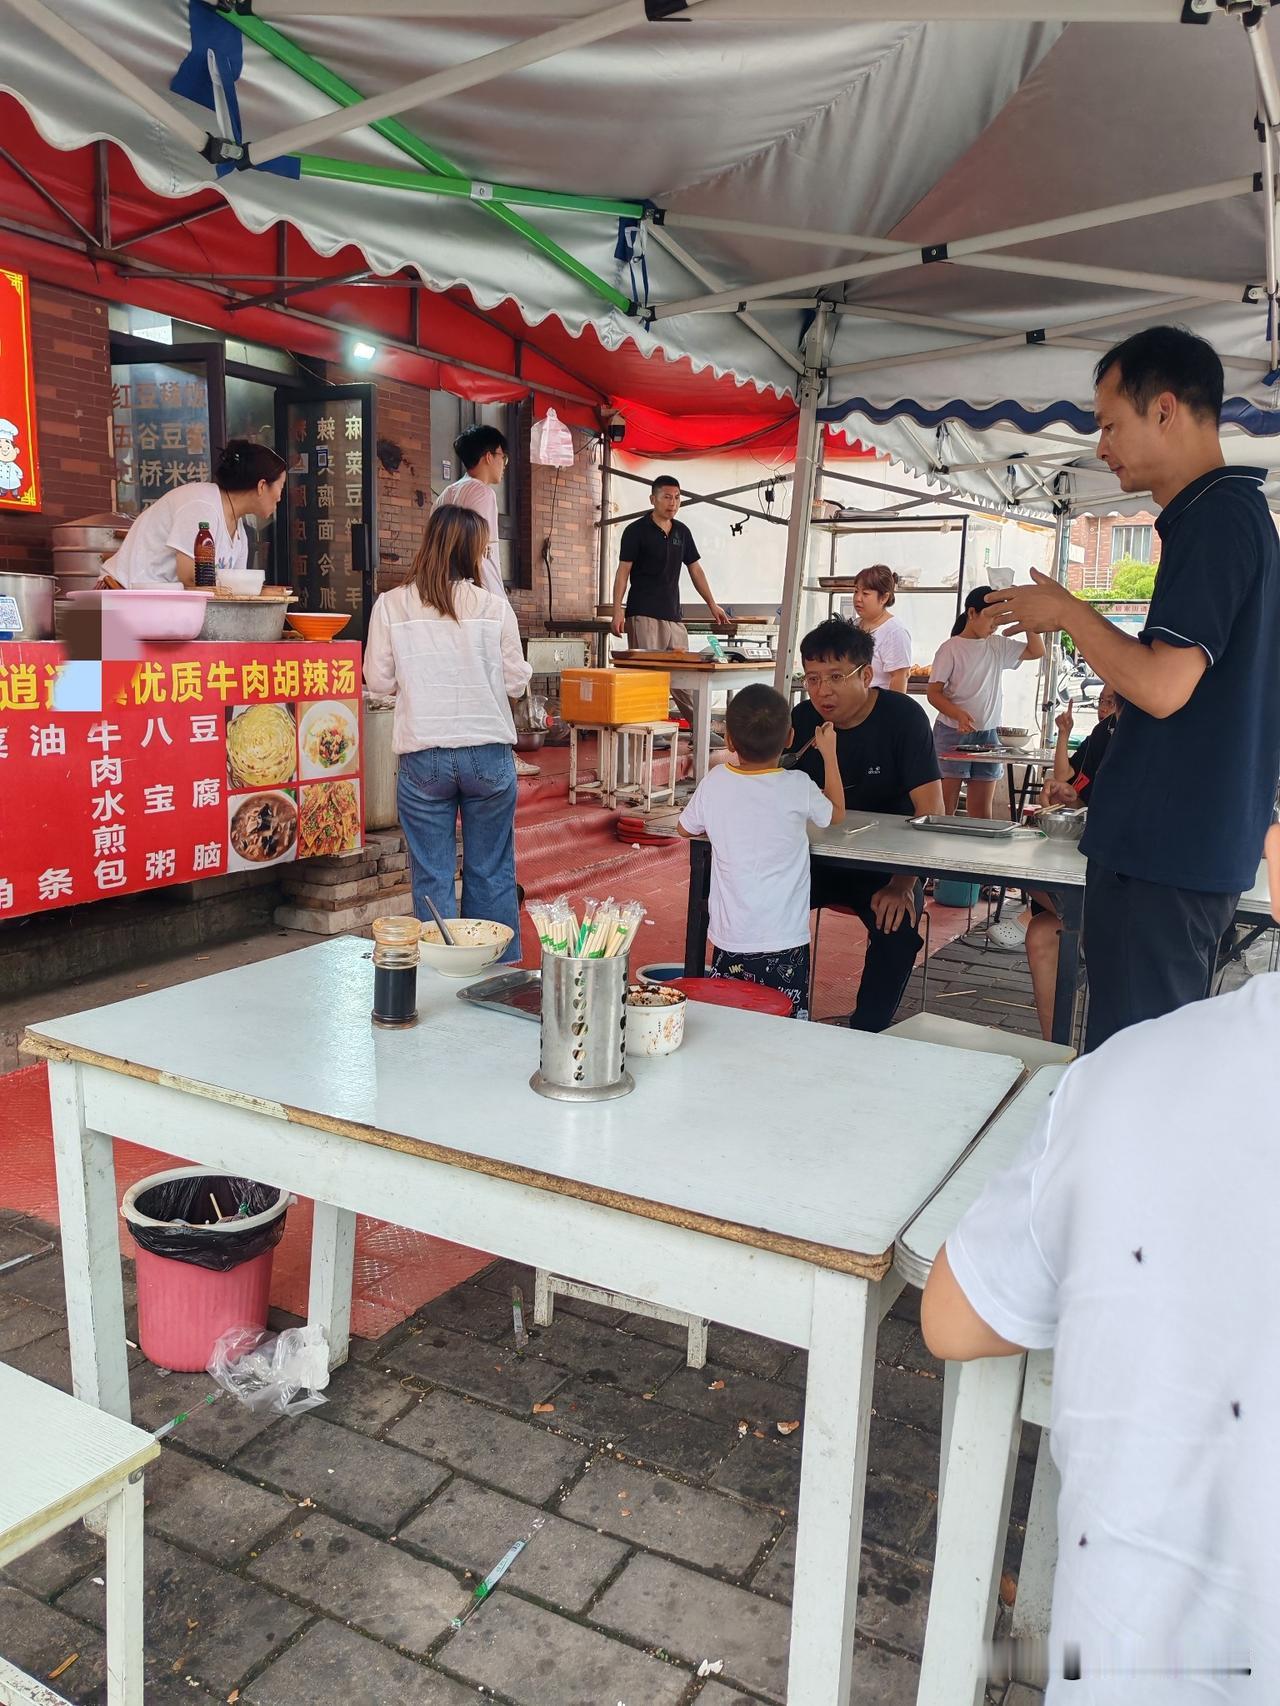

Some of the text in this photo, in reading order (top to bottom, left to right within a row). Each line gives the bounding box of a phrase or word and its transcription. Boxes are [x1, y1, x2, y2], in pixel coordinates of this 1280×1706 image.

[87, 720, 127, 890] 牛肉水煎包
[140, 717, 176, 881] 八宝粥
[189, 714, 222, 871] 豆腐脑
